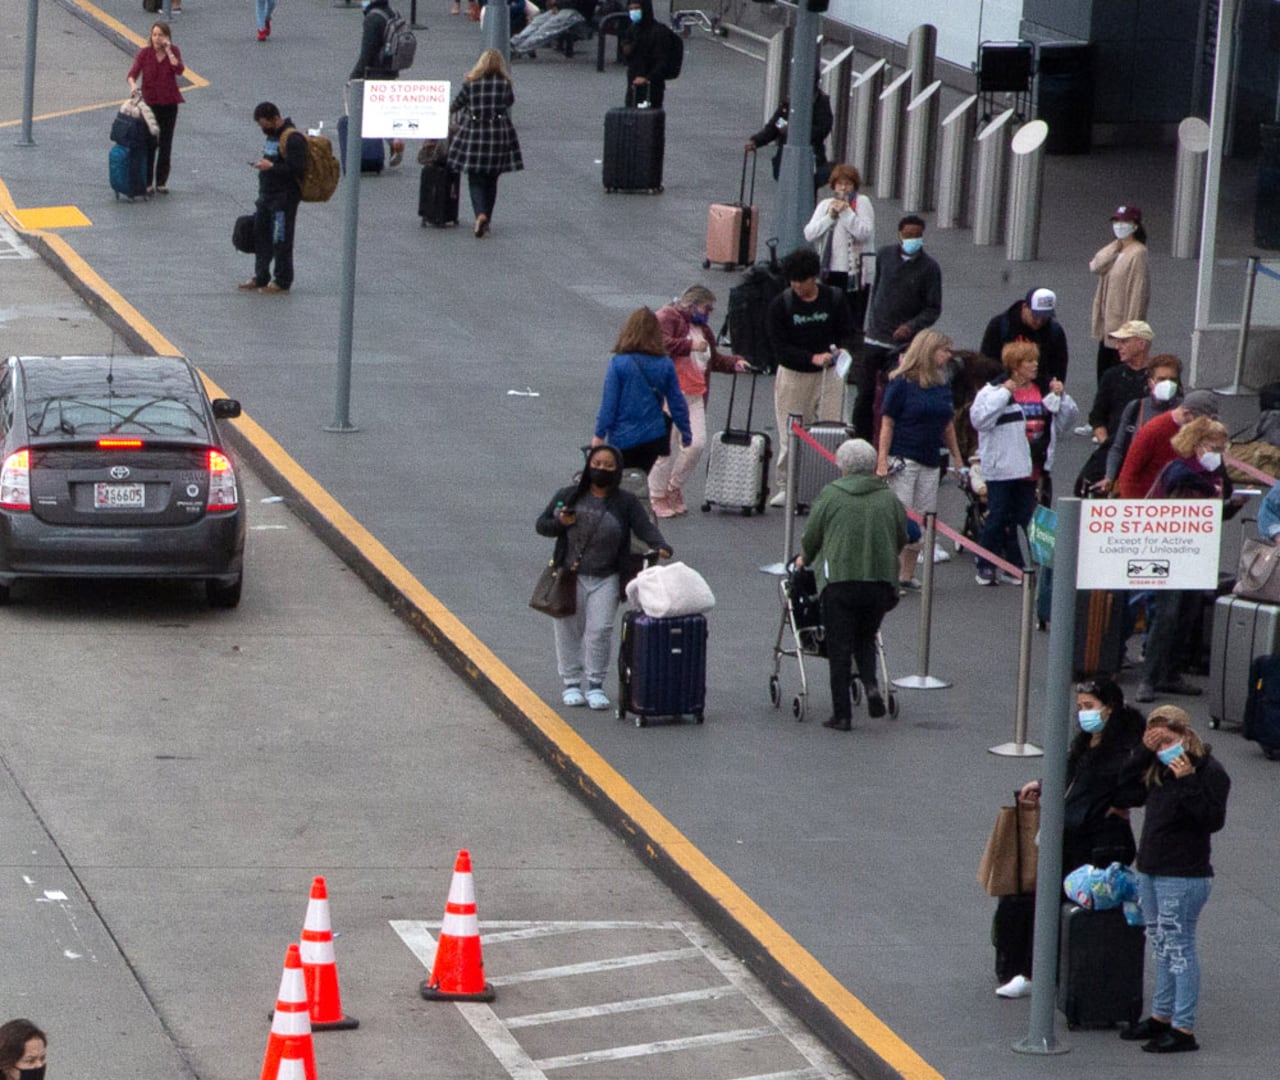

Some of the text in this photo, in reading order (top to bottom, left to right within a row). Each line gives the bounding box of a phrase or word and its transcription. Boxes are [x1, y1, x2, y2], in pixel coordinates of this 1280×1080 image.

[370, 85, 446, 93] NO STOPPING
[369, 95, 446, 103] OR STANDING
[1090, 505, 1214, 518] NO STOPPING
[1088, 521, 1214, 534] OR STANDING
[1107, 536, 1194, 547] Except for Active
[1099, 546, 1139, 556] Loading
[1150, 545, 1201, 556] Unloading
